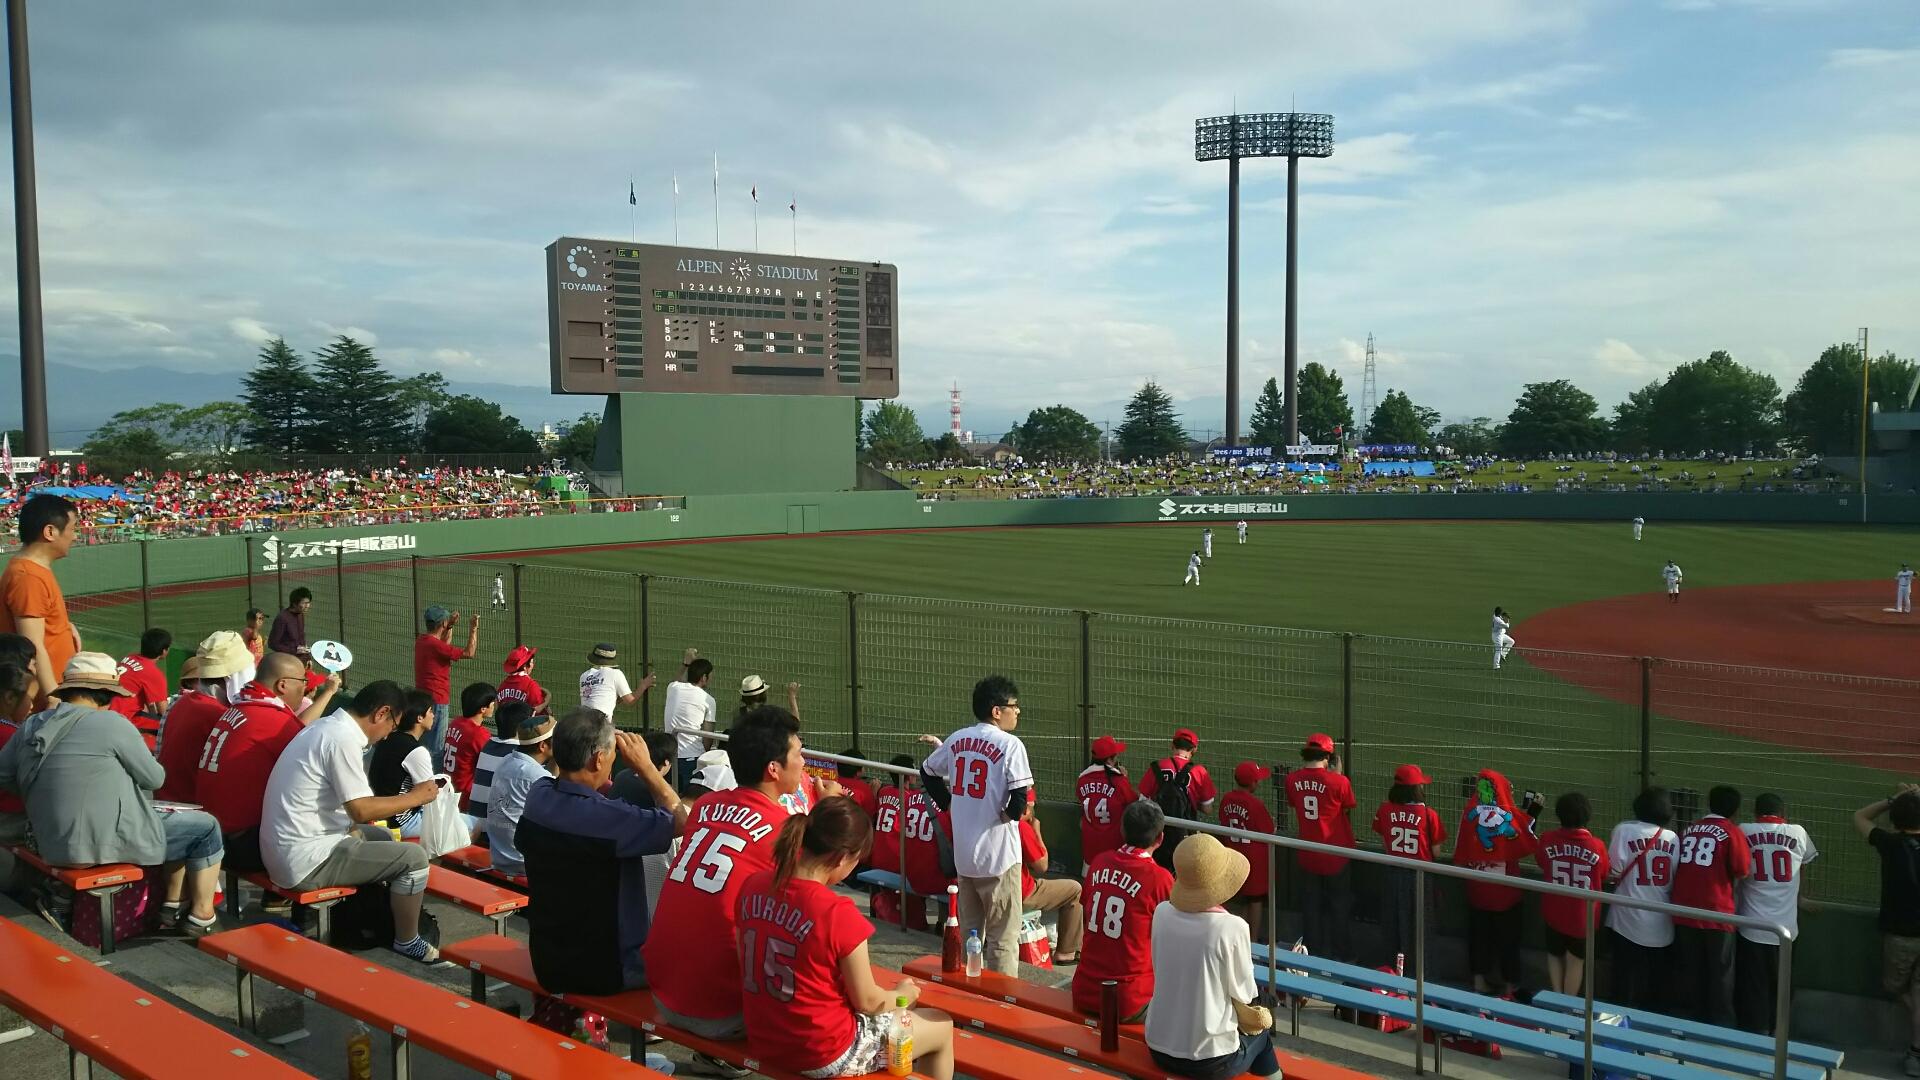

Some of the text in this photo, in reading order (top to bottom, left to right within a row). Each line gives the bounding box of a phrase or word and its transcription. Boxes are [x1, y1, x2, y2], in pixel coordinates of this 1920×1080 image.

[676, 258, 818, 281] ALPEN STADIUM
[561, 282, 603, 292] TOYAMA
[680, 282, 684, 290] 1
[689, 283, 695, 291] 2
[699, 283, 705, 291] 3
[718, 285, 724, 293] 5
[736, 286, 742, 294] 7
[745, 286, 751, 294] 8
[755, 287, 760, 295] 9
[763, 288, 771, 296] 10
[775, 288, 781, 296] R
[797, 290, 803, 298] H
[816, 291, 821, 299] E
[664, 318, 670, 326] B
[664, 326, 671, 334] S
[709, 320, 716, 328] H
[710, 328, 715, 336] E
[733, 330, 744, 339] PL
[765, 332, 775, 340] 1B
[664, 351, 677, 359] AV
[734, 343, 804, 354] 2B 3B R
[665, 363, 677, 371] HR
[670, 514, 680, 522] 122
[1180, 502, 1288, 514] スズキ自販富山
[288, 534, 416, 559] スズキ自販富山
[199, 727, 229, 773] 51
[952, 756, 988, 800] 13
[1295, 780, 1326, 793] MARU
[876, 807, 896, 832] 15
[1083, 797, 1110, 823] 14
[1304, 795, 1319, 820] 9
[1391, 811, 1421, 826] ARAI
[698, 803, 773, 842] KURODA
[905, 808, 934, 841] 30
[1391, 826, 1419, 855] 25
[1680, 836, 1716, 867] 38
[669, 827, 747, 894] 15
[1546, 844, 1600, 865] ELDRED
[1752, 849, 1792, 882] 10
[1636, 853, 1672, 887] 19
[1092, 868, 1141, 898] MAEDA
[741, 894, 814, 943] KURODA
[1088, 891, 1126, 939] 18
[743, 928, 797, 1002] 15
